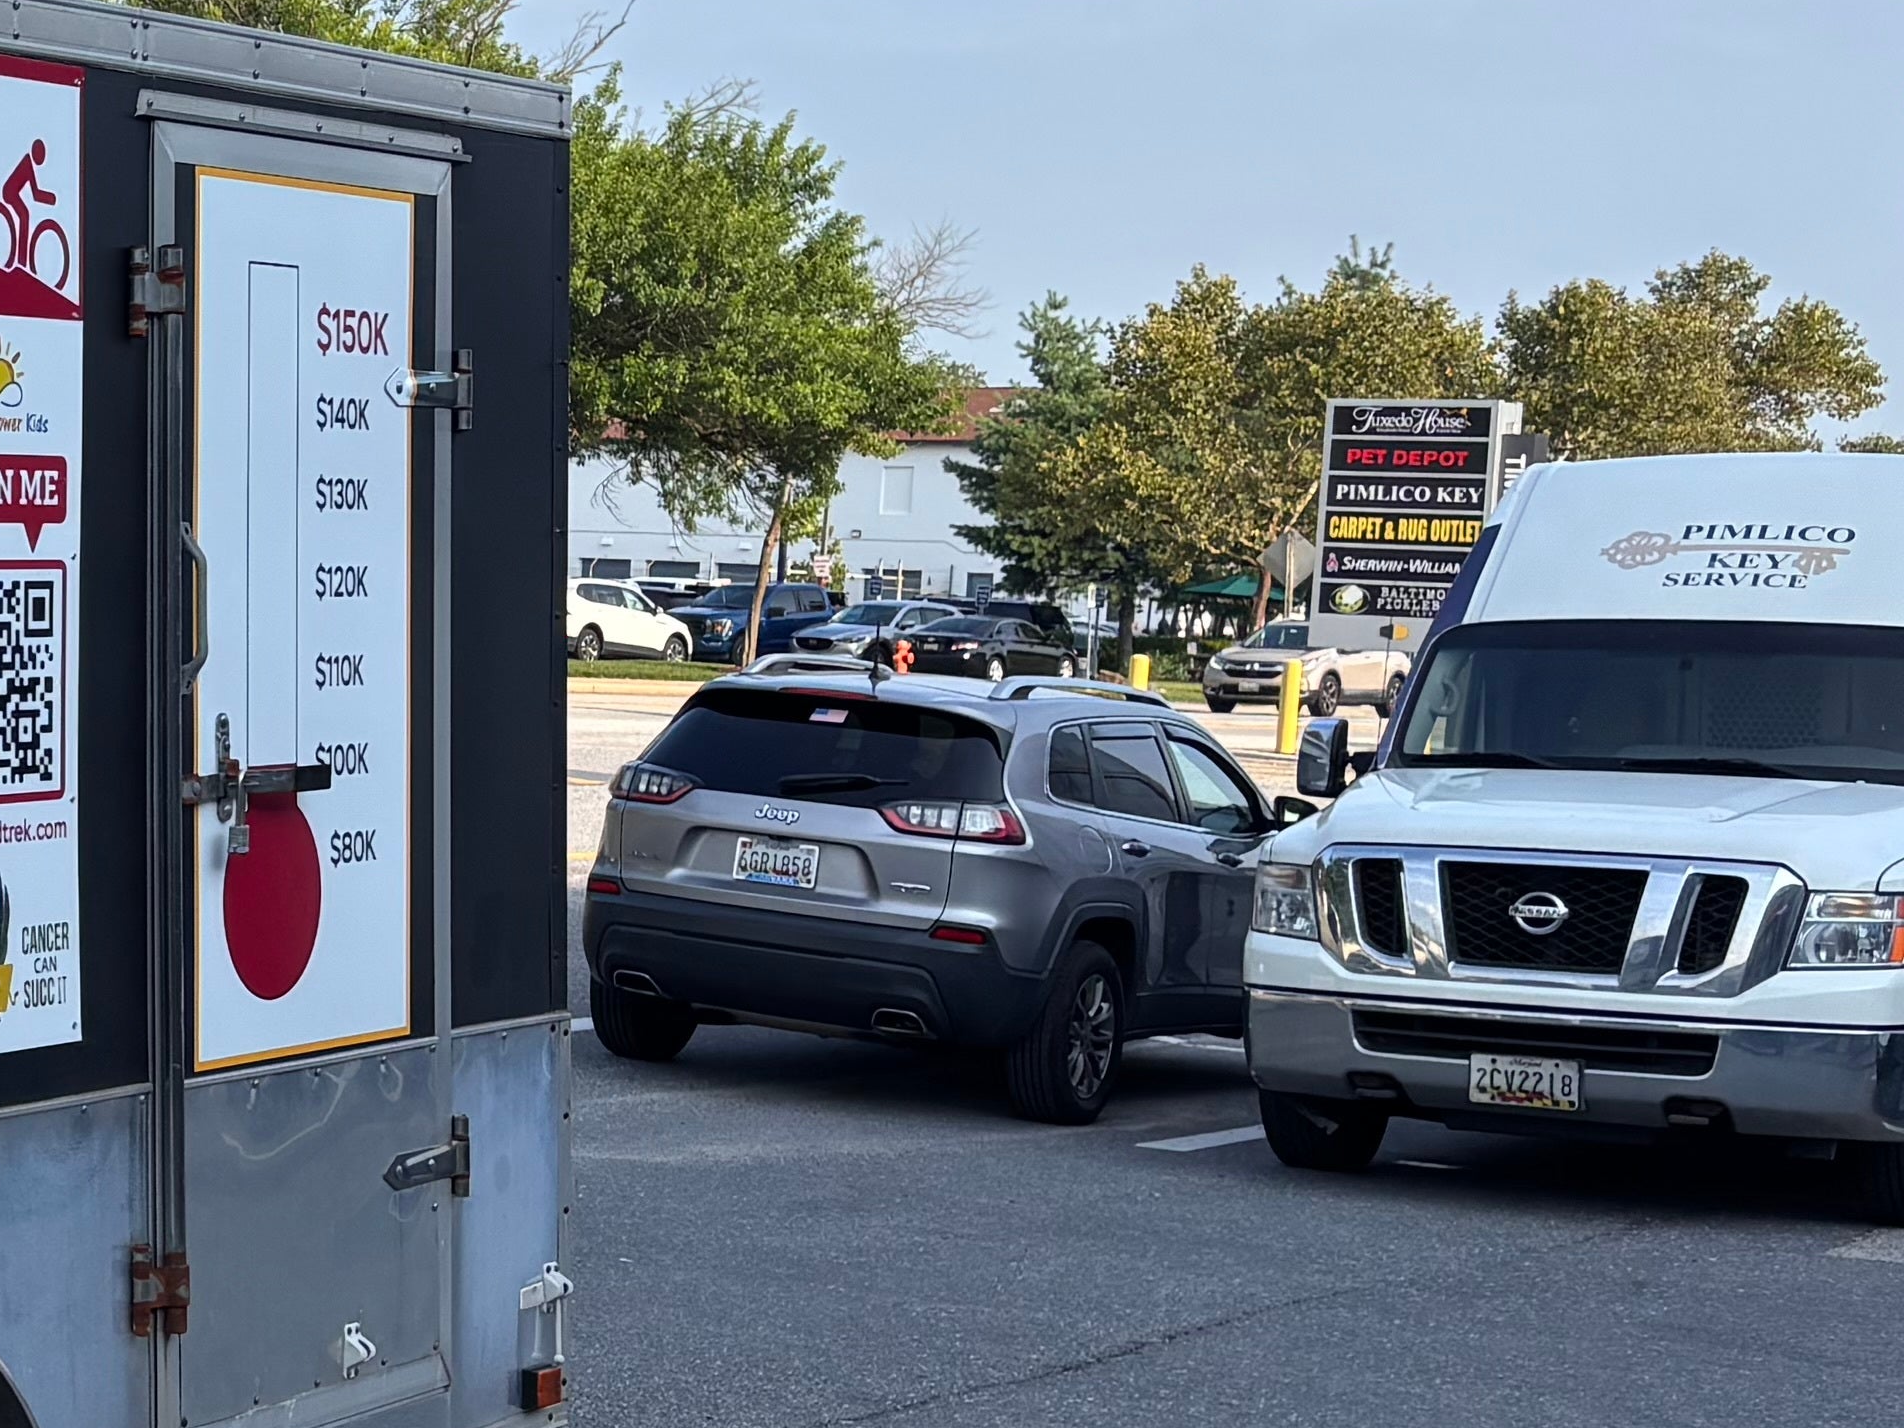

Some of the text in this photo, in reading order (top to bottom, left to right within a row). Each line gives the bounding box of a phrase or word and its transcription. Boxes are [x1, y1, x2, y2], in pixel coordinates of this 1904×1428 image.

[316, 302, 389, 357] $150K
[26, 412, 48, 433] Kids
[316, 394, 369, 431] $140K
[1352, 407, 1465, 434] Tuxedo House
[1347, 449, 1469, 467] PET DEPOT
[19, 470, 58, 505] ME
[315, 475, 368, 512] $130K
[1336, 484, 1483, 503] PIMLICO KEY
[1330, 516, 1481, 543] CARPET & RUG OUTLET
[1682, 525, 1856, 543] PIMLICO
[1706, 553, 1792, 569] KEY
[315, 562, 368, 600] $120K
[1662, 573, 1808, 588] SERVICE
[315, 653, 363, 690] $110K
[316, 742, 368, 775] $100K
[755, 804, 800, 825] Jeep
[331, 829, 376, 868] $80K
[22, 922, 69, 955] CANCER
[34, 955, 57, 973] CAN
[24, 976, 67, 1008] SUCC IT
[1477, 1068, 1572, 1098] 2CV2218
